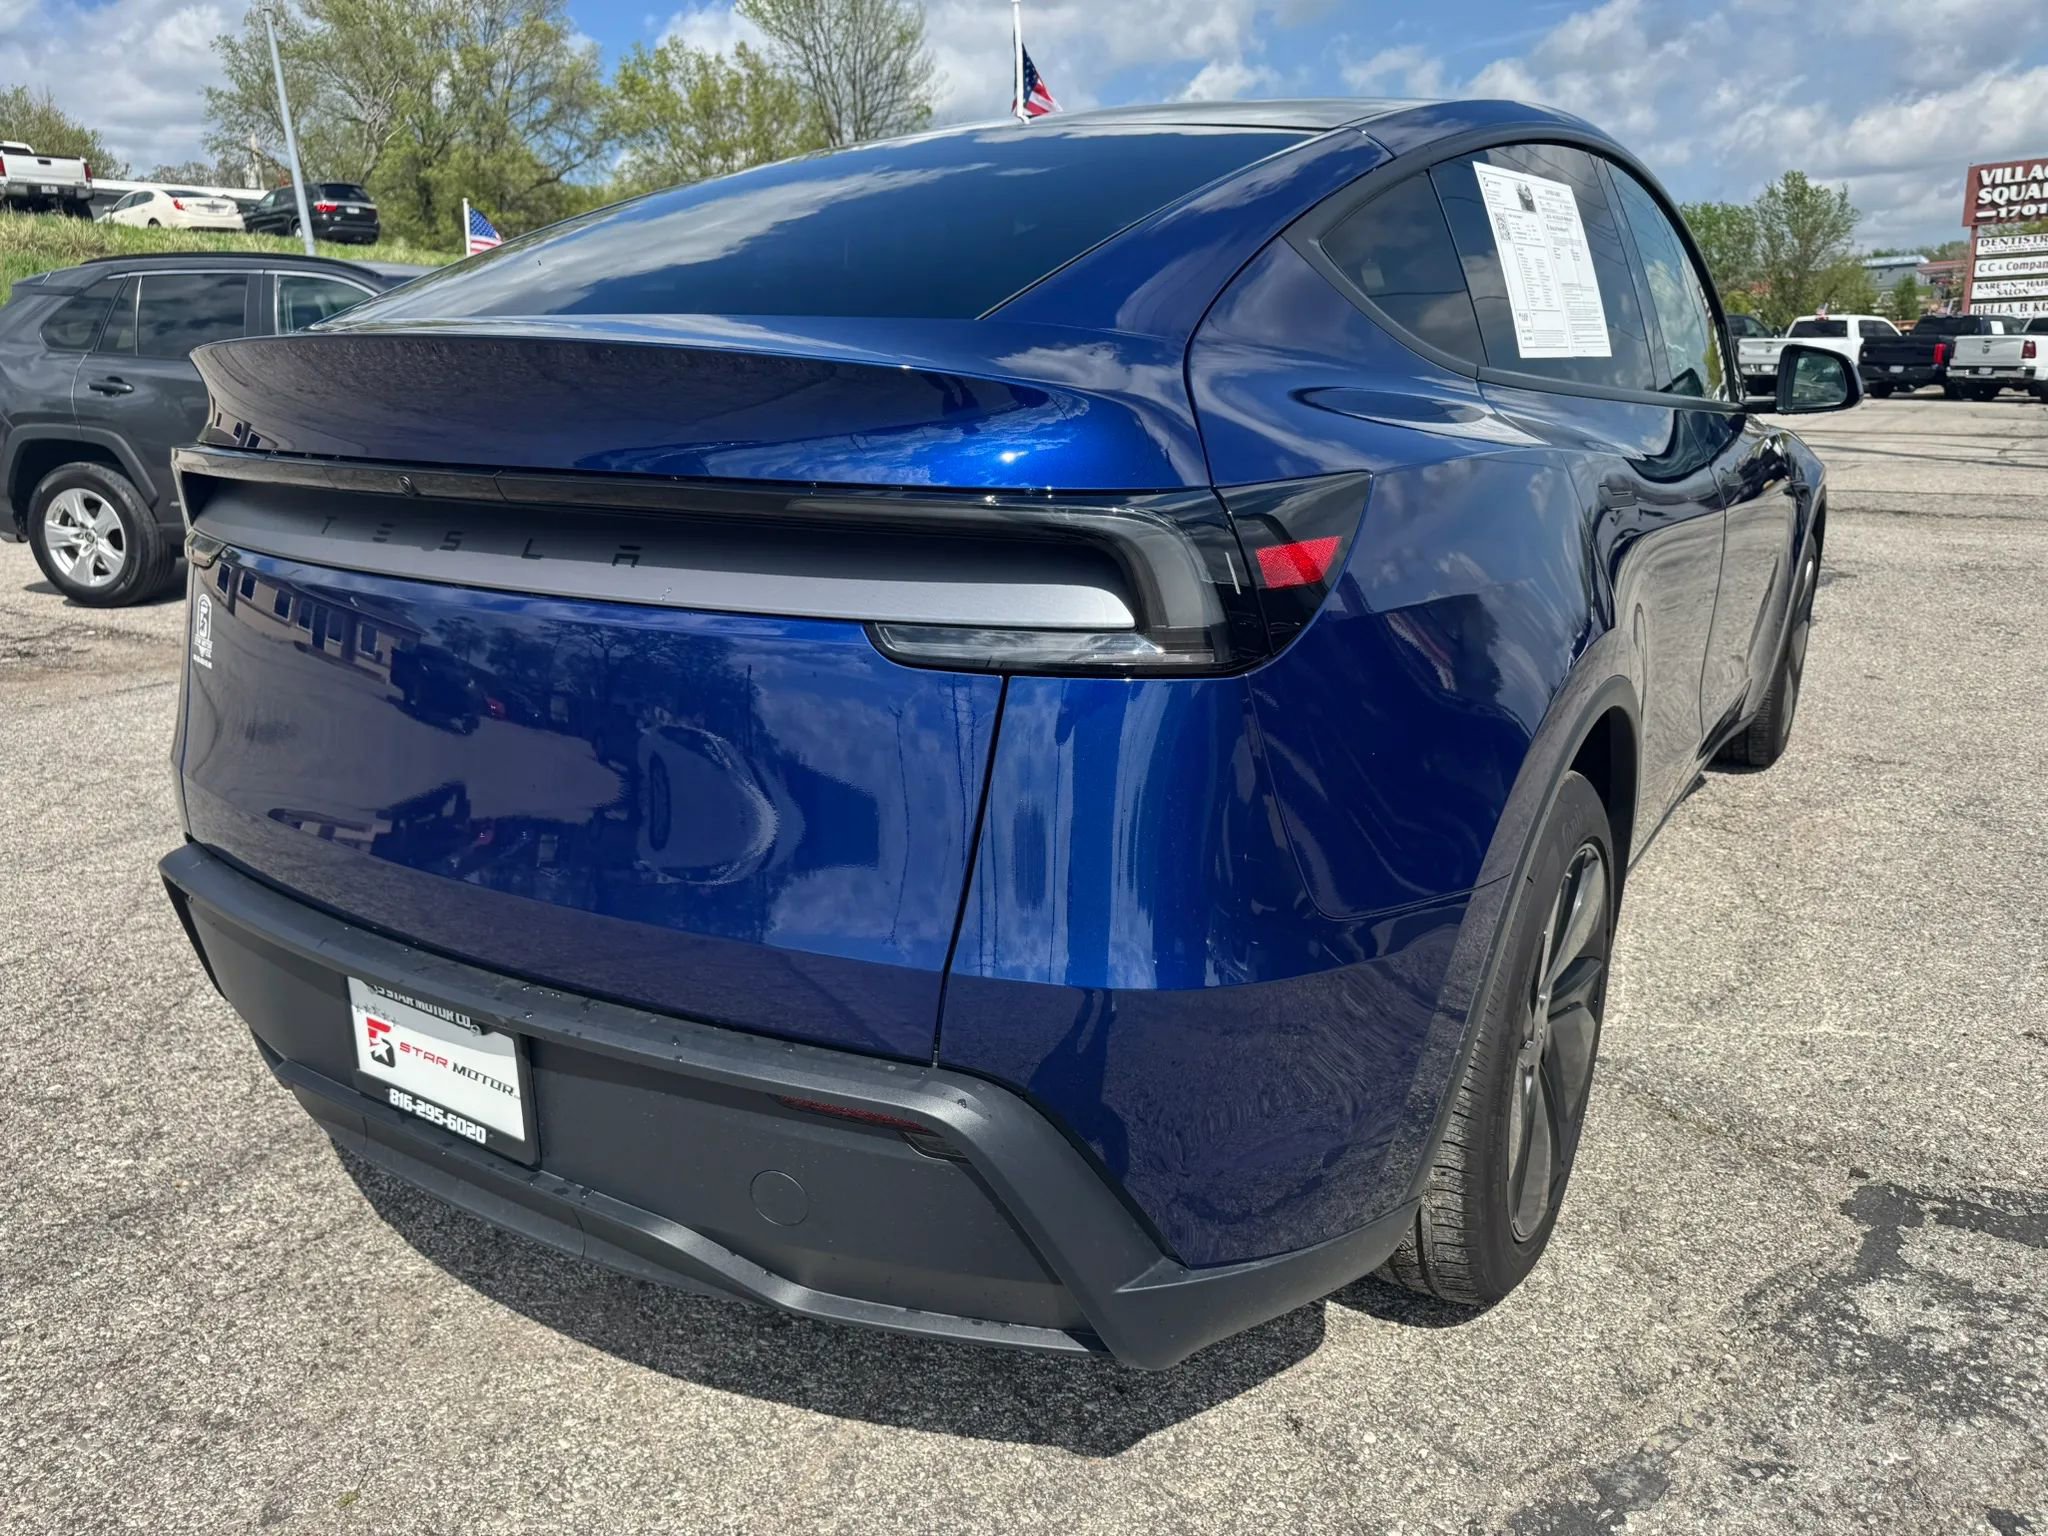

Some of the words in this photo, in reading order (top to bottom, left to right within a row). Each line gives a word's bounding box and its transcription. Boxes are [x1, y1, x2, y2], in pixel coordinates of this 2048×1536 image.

[1996, 288, 2029, 296] SALON
[321, 515, 643, 569] TESLA
[399, 1041, 448, 1069] STAR
[452, 1062, 514, 1097] MOTOR
[388, 1088, 487, 1145] 816-295-6020
